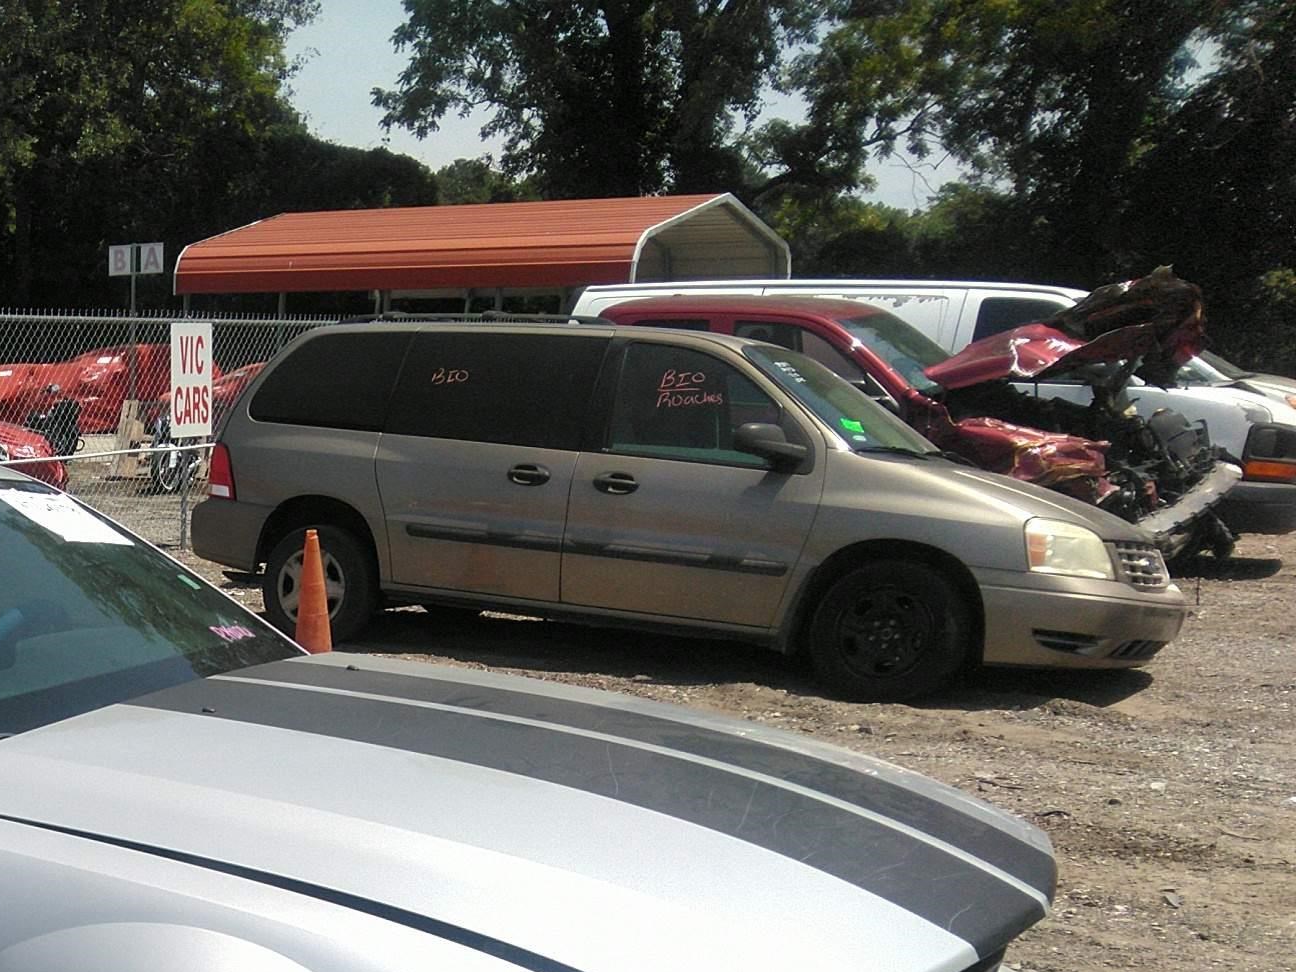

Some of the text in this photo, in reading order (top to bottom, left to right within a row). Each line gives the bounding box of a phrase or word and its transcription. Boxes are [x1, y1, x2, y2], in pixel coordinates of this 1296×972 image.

[113, 252, 127, 272] B
[143, 246, 160, 270] A
[179, 335, 205, 375] VIC
[431, 367, 469, 385] BIO
[660, 369, 706, 388] BIO
[174, 384, 209, 426] CARS
